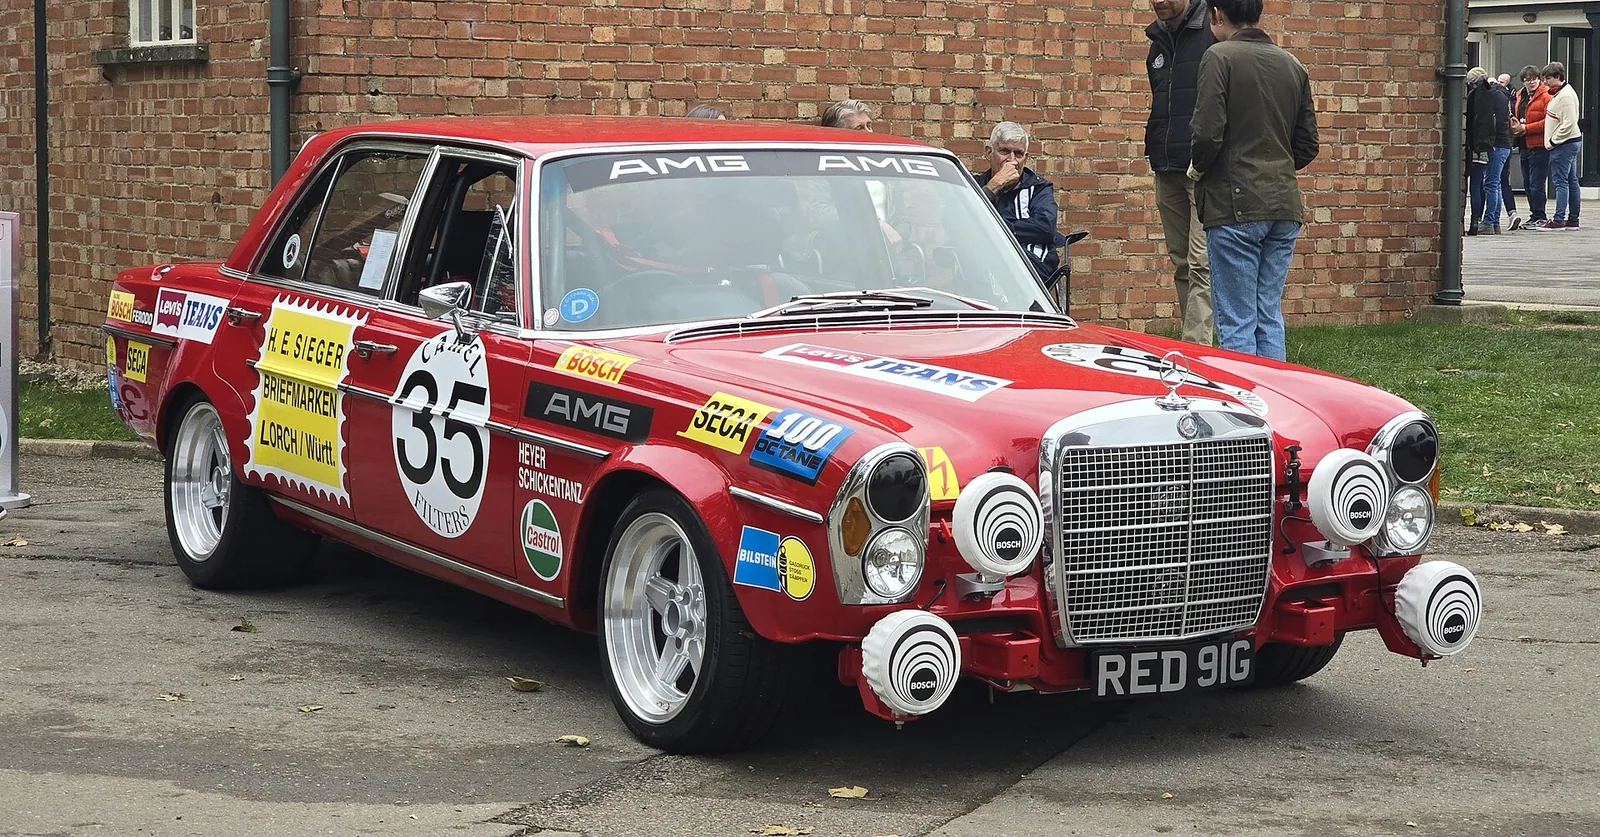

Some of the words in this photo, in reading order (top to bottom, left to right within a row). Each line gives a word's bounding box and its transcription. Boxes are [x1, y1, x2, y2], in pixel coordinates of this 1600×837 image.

[609, 155, 751, 179] AMG
[817, 155, 940, 177] AMG
[111, 299, 133, 320] BOSCH
[159, 300, 182, 317] Levi's
[183, 300, 223, 331] JEANS
[571, 299, 589, 316] D
[127, 347, 146, 375] SECA
[267, 327, 278, 353] H.
[280, 331, 291, 356] E.
[293, 333, 344, 370] SIEGER
[566, 352, 625, 381] BOSCH
[863, 360, 998, 391] JEANS
[263, 374, 338, 419] BRIEFMARKEN
[543, 392, 631, 434] AMG
[693, 400, 757, 442] SECA
[260, 419, 297, 454] LORCH
[305, 431, 336, 467] Württ.
[395, 369, 488, 500] 35
[765, 412, 843, 451] 100
[518, 441, 546, 470] HEYER
[755, 438, 823, 470] OCTANE
[518, 466, 583, 505] SCHICKENTANZ
[414, 489, 470, 534] FILTERS
[1350, 510, 1372, 520] BOSCH
[526, 526, 560, 554] Castrol
[996, 540, 1021, 550] BOSCH
[739, 549, 777, 569] BILSTEIN
[1443, 624, 1465, 635] BOSCH
[910, 680, 937, 691] BOSCH
[1097, 650, 1188, 696] RED
